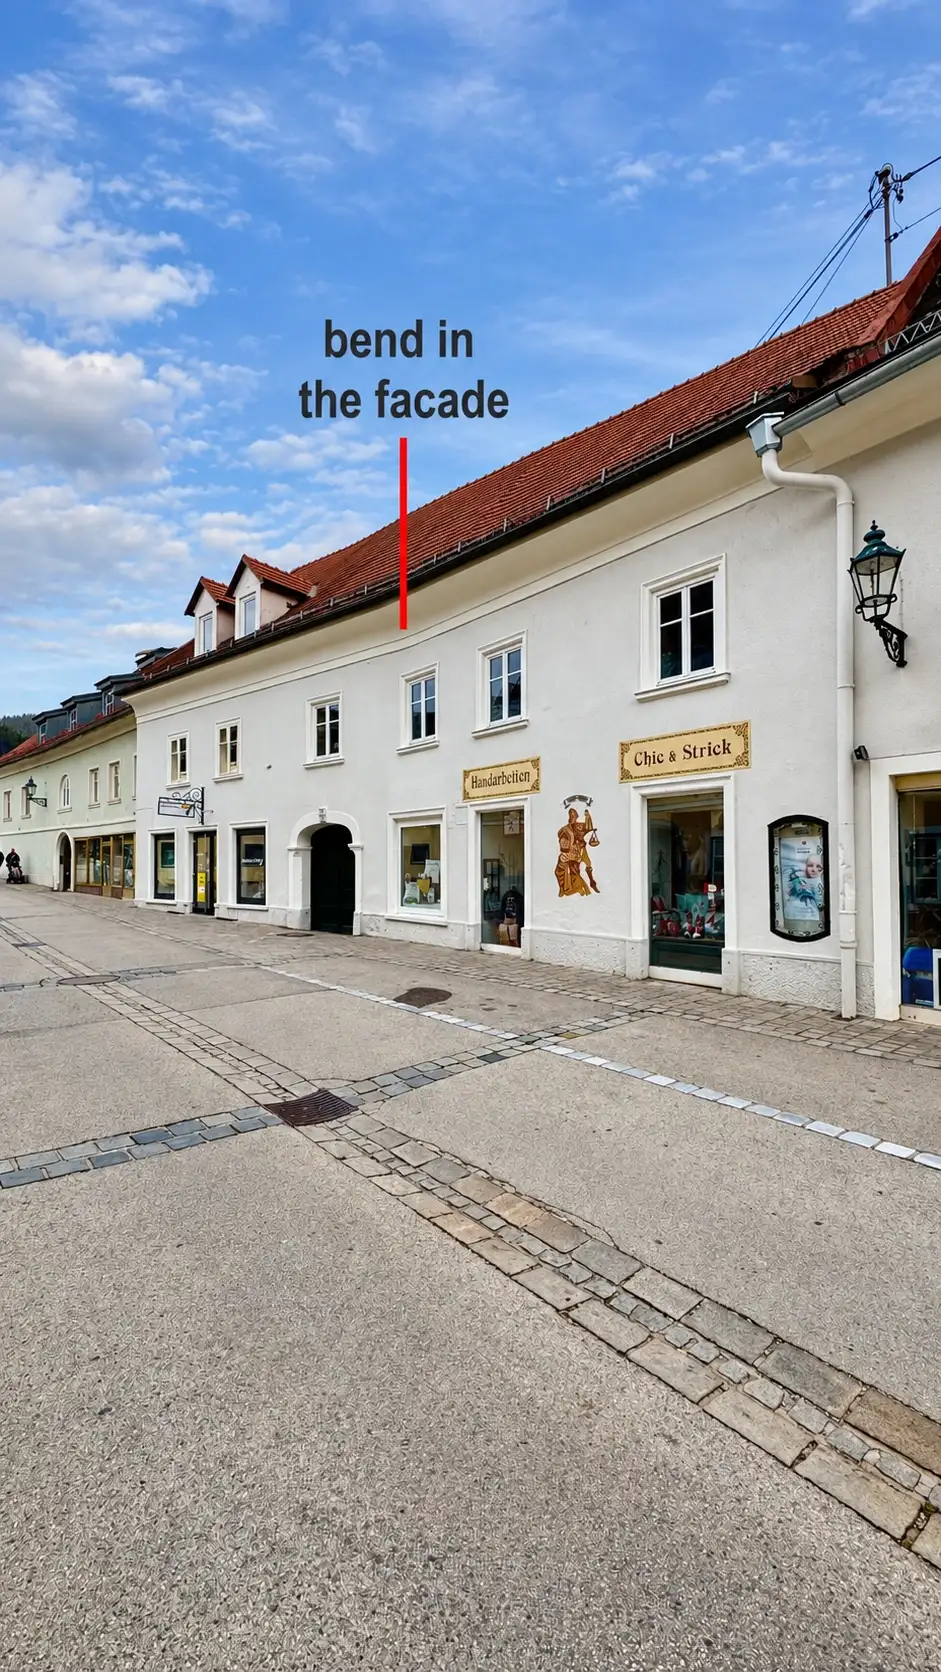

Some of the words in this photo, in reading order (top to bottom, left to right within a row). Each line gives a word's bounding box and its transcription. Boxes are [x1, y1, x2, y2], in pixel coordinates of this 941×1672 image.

[634, 751, 664, 768] Chic
[668, 750, 677, 763] &
[682, 738, 732, 760] Strick
